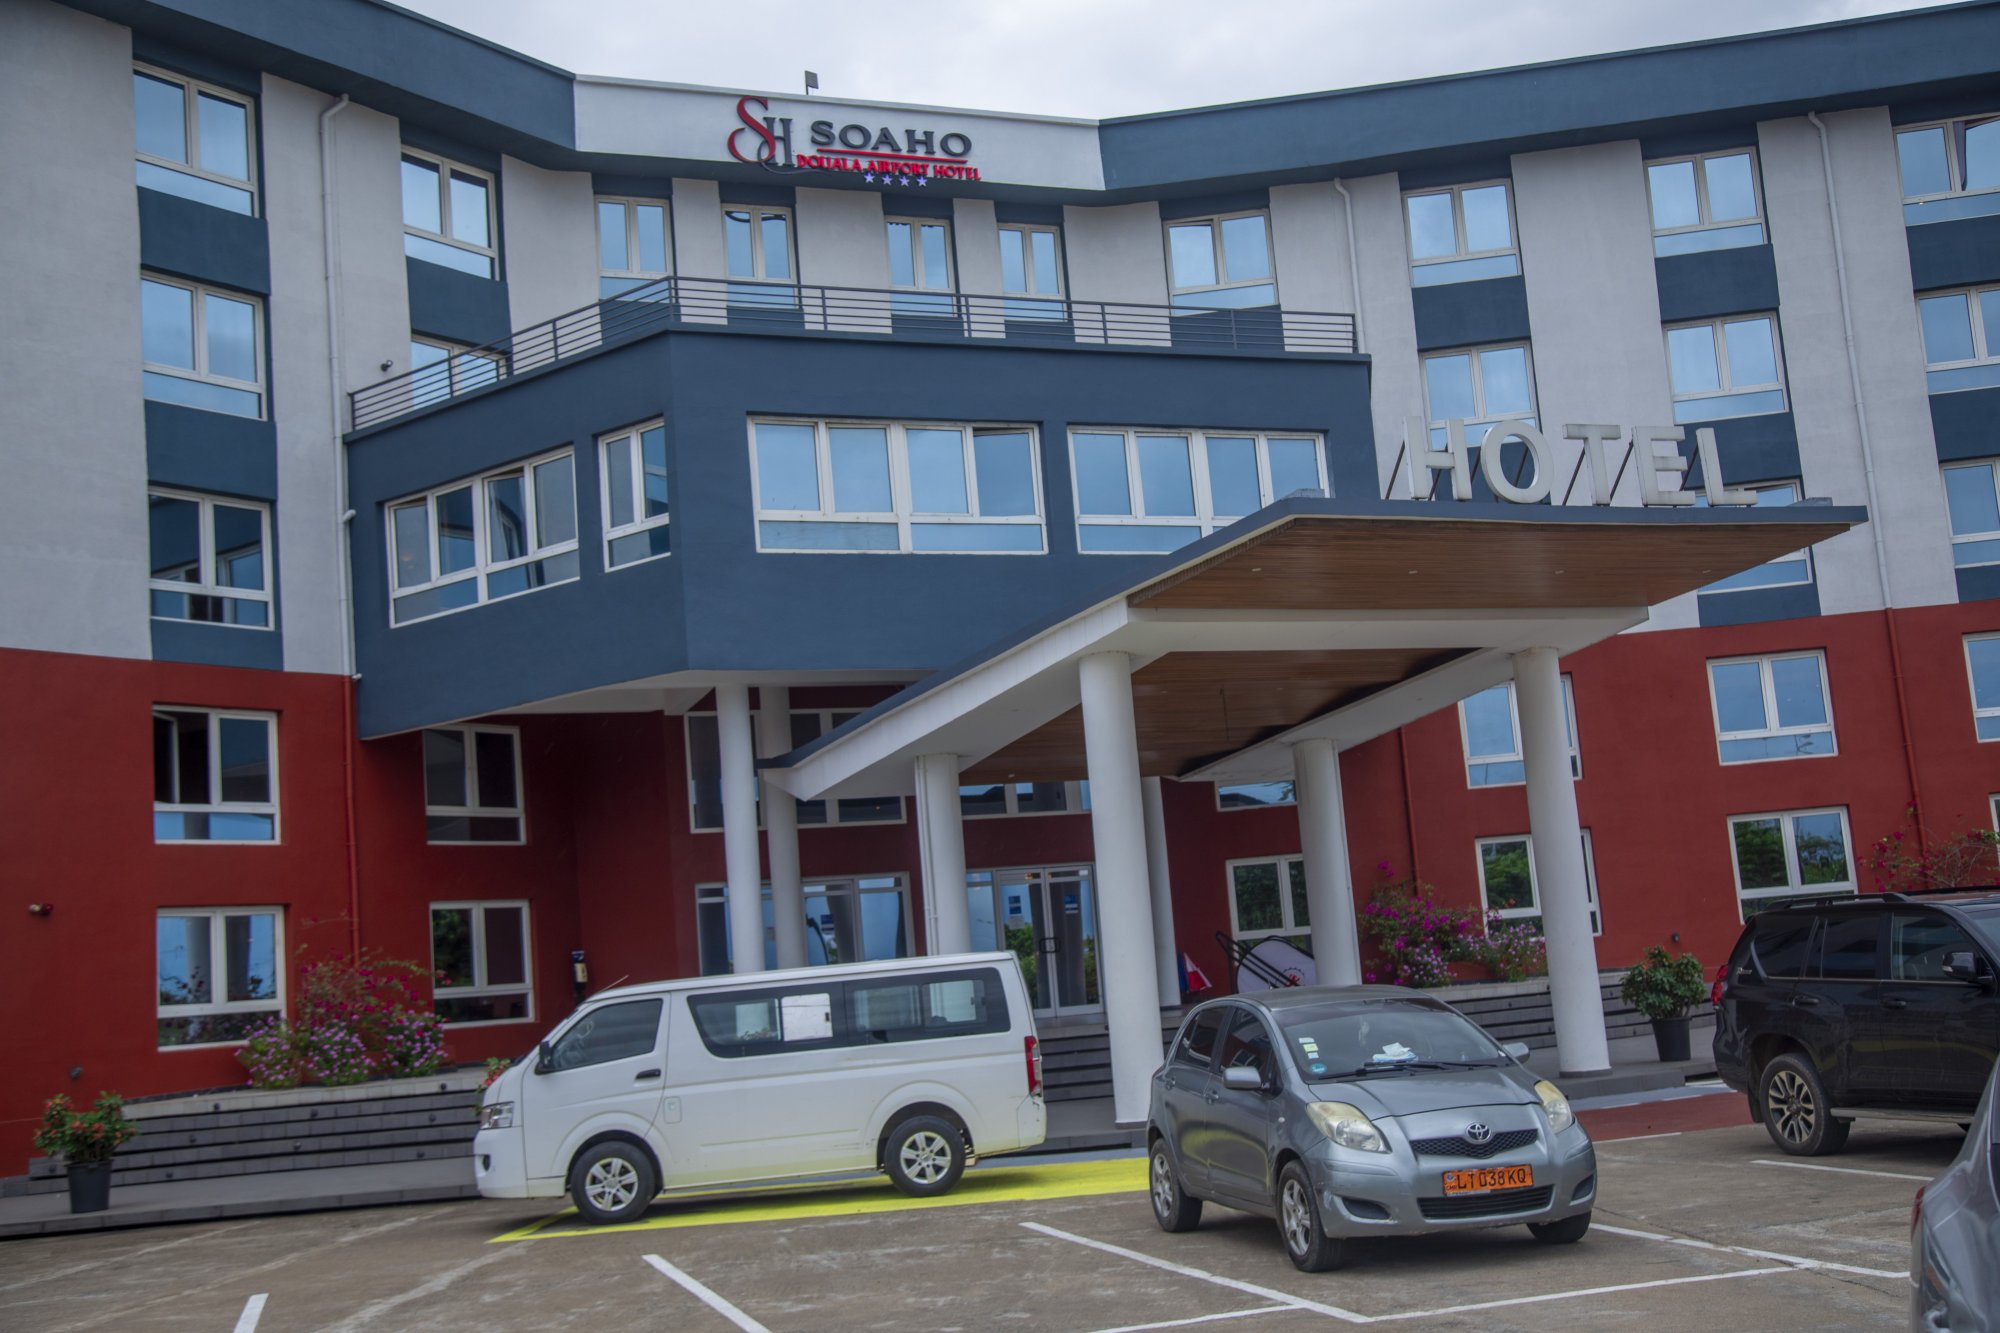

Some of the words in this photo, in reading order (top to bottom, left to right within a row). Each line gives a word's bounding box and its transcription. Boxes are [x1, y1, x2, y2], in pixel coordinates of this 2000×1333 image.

[810, 119, 973, 157] SOAHO
[796, 153, 863, 173] DOUALA
[866, 159, 930, 177] AIRPORT
[932, 164, 982, 181] HOTEL
[1403, 415, 1758, 506] HOTEL
